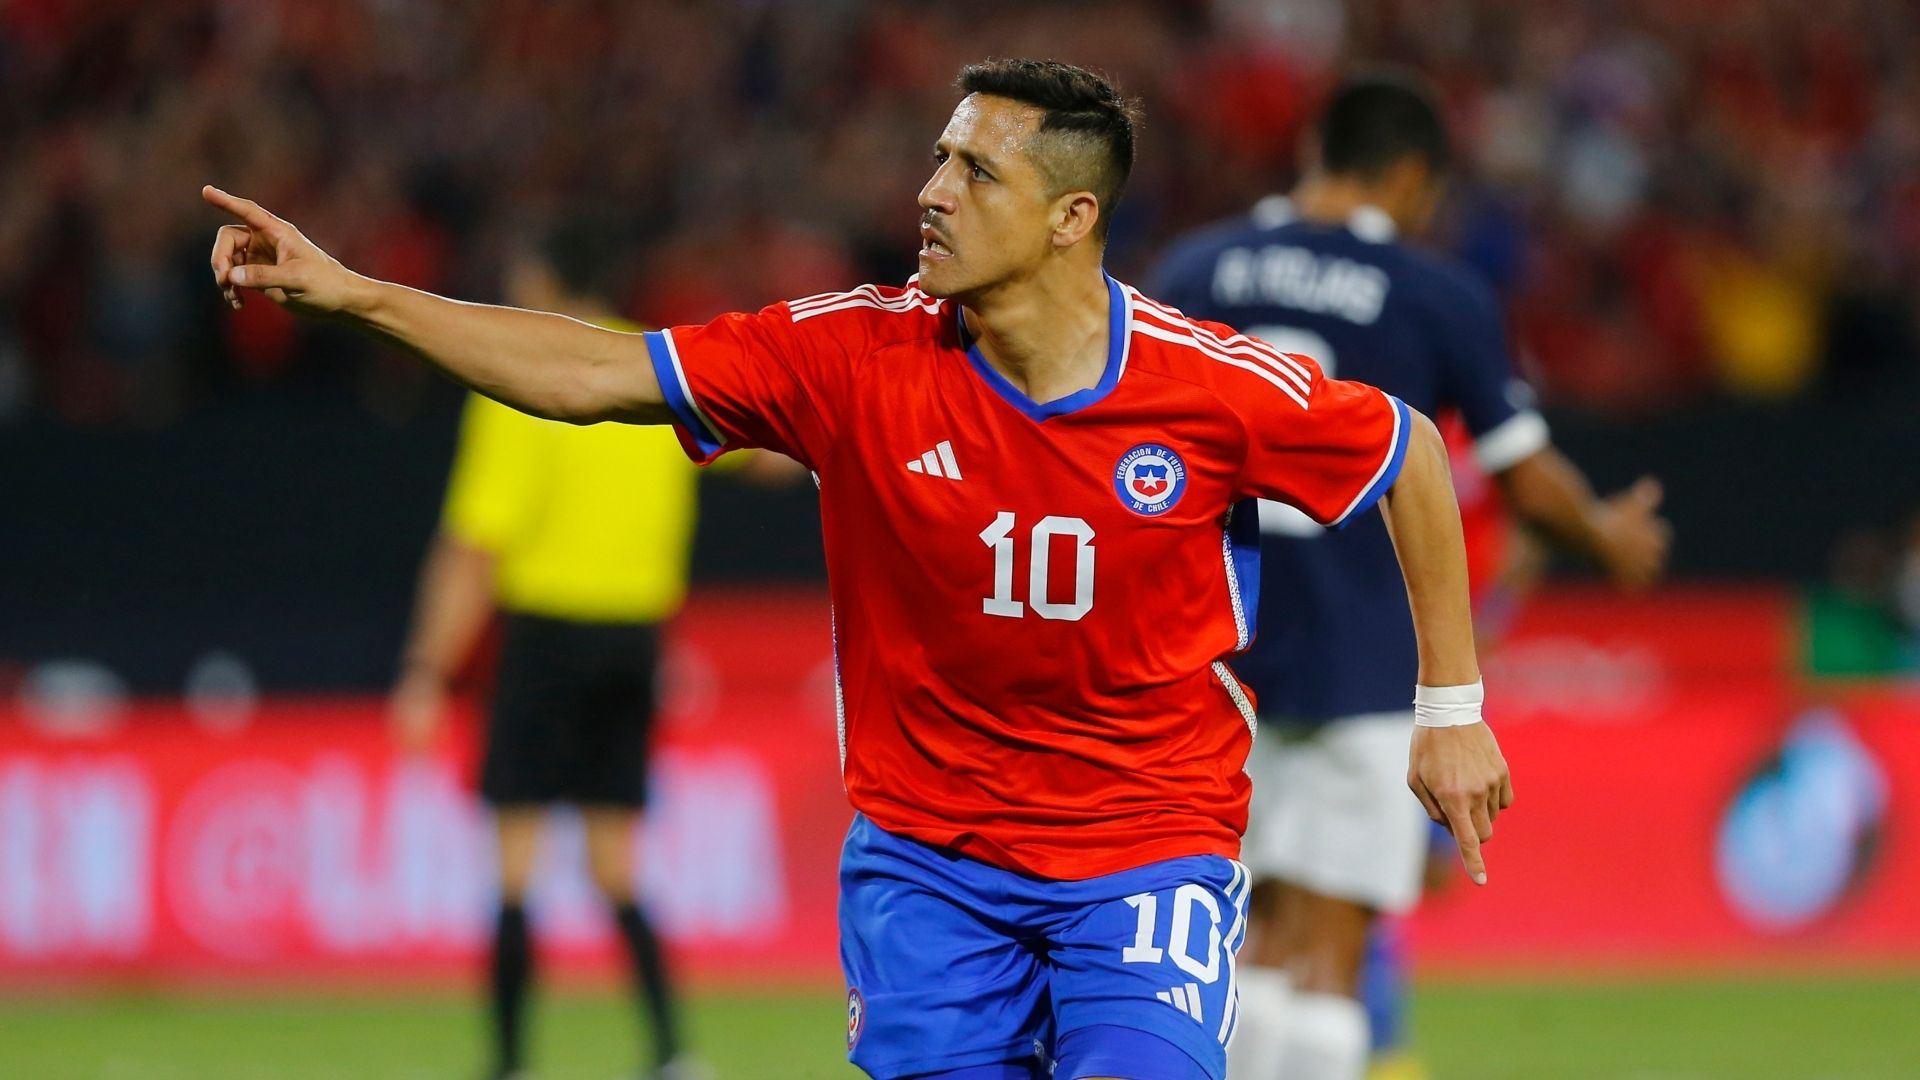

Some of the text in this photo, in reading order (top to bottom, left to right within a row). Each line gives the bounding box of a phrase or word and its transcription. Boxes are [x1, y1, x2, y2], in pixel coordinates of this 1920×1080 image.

[1116, 447, 1185, 482] FEDERACION DE FUTBOL
[1133, 500, 1169, 513] DE CHILE
[979, 511, 1096, 621] 10
[1122, 883, 1222, 984] 10
